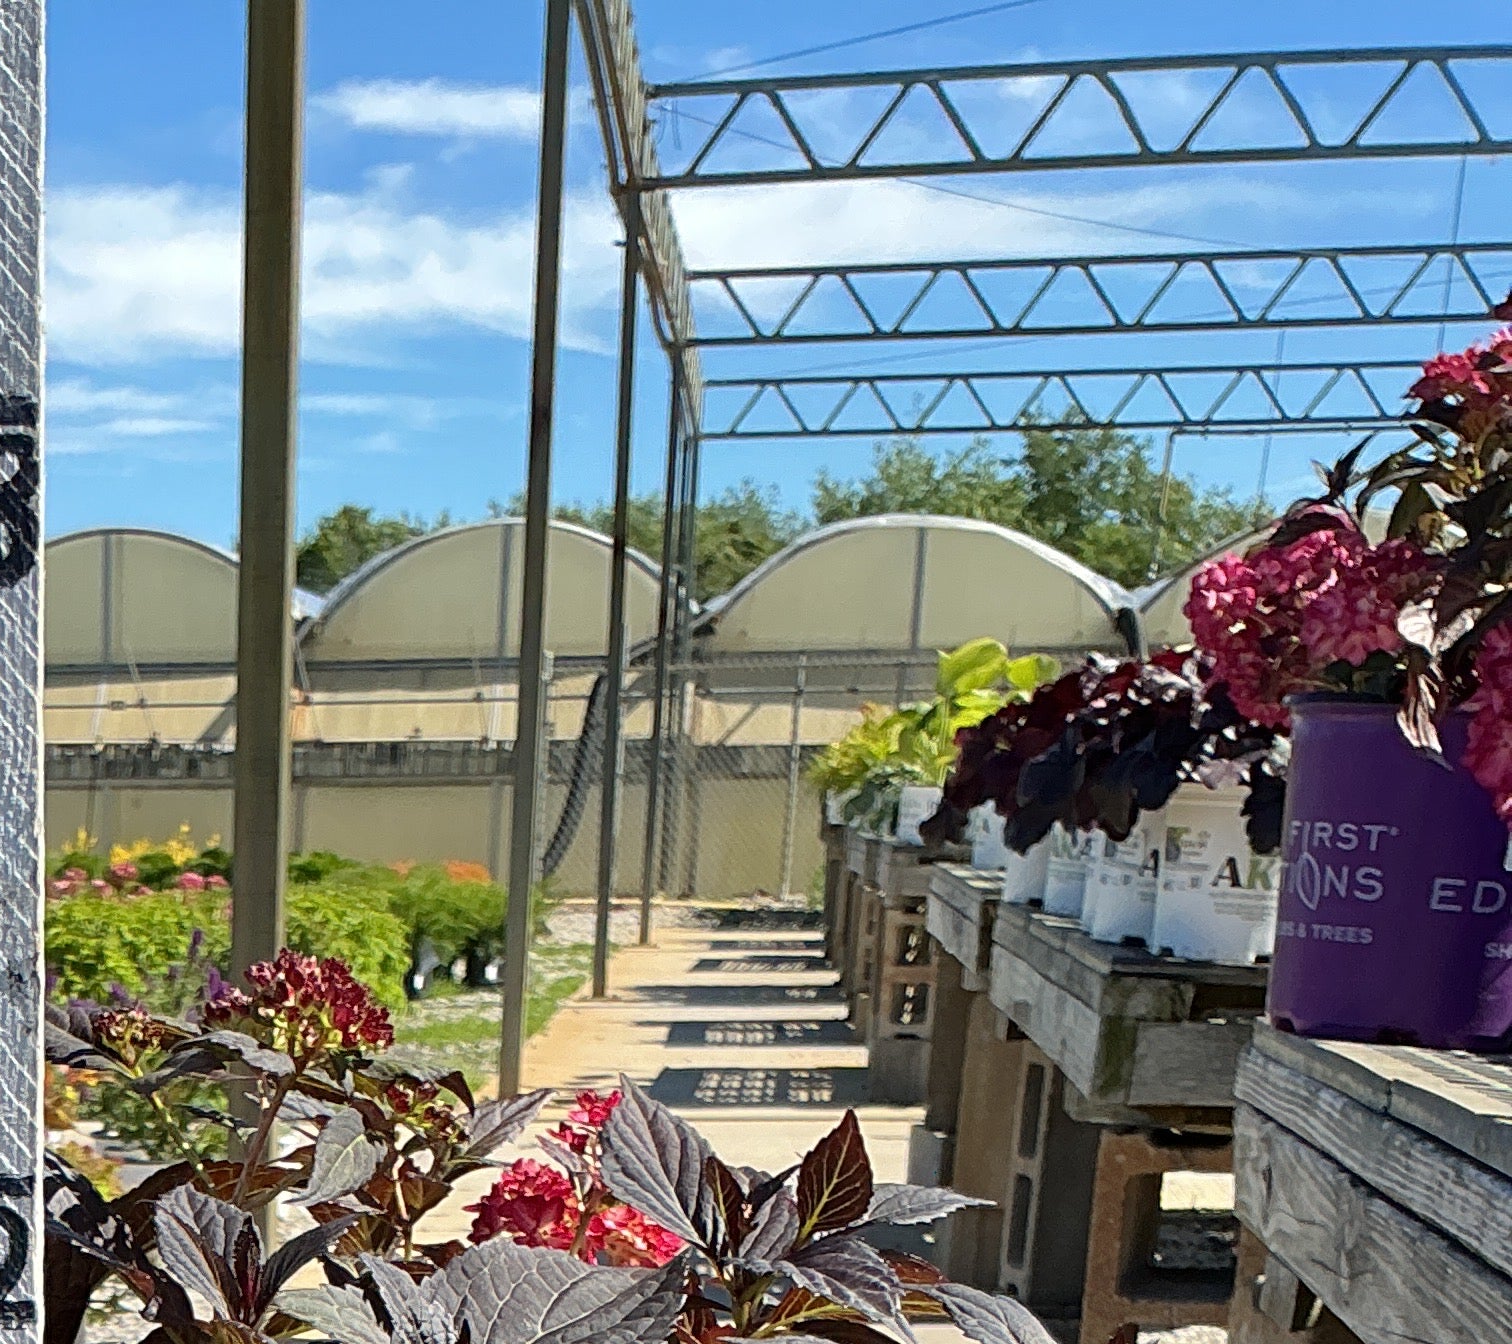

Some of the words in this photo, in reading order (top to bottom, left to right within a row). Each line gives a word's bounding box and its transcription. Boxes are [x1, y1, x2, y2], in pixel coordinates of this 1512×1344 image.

[1289, 819, 1387, 851] FIRST
[1288, 852, 1384, 911] IONS
[1429, 877, 1508, 914] ED
[1312, 924, 1373, 944] TREES
